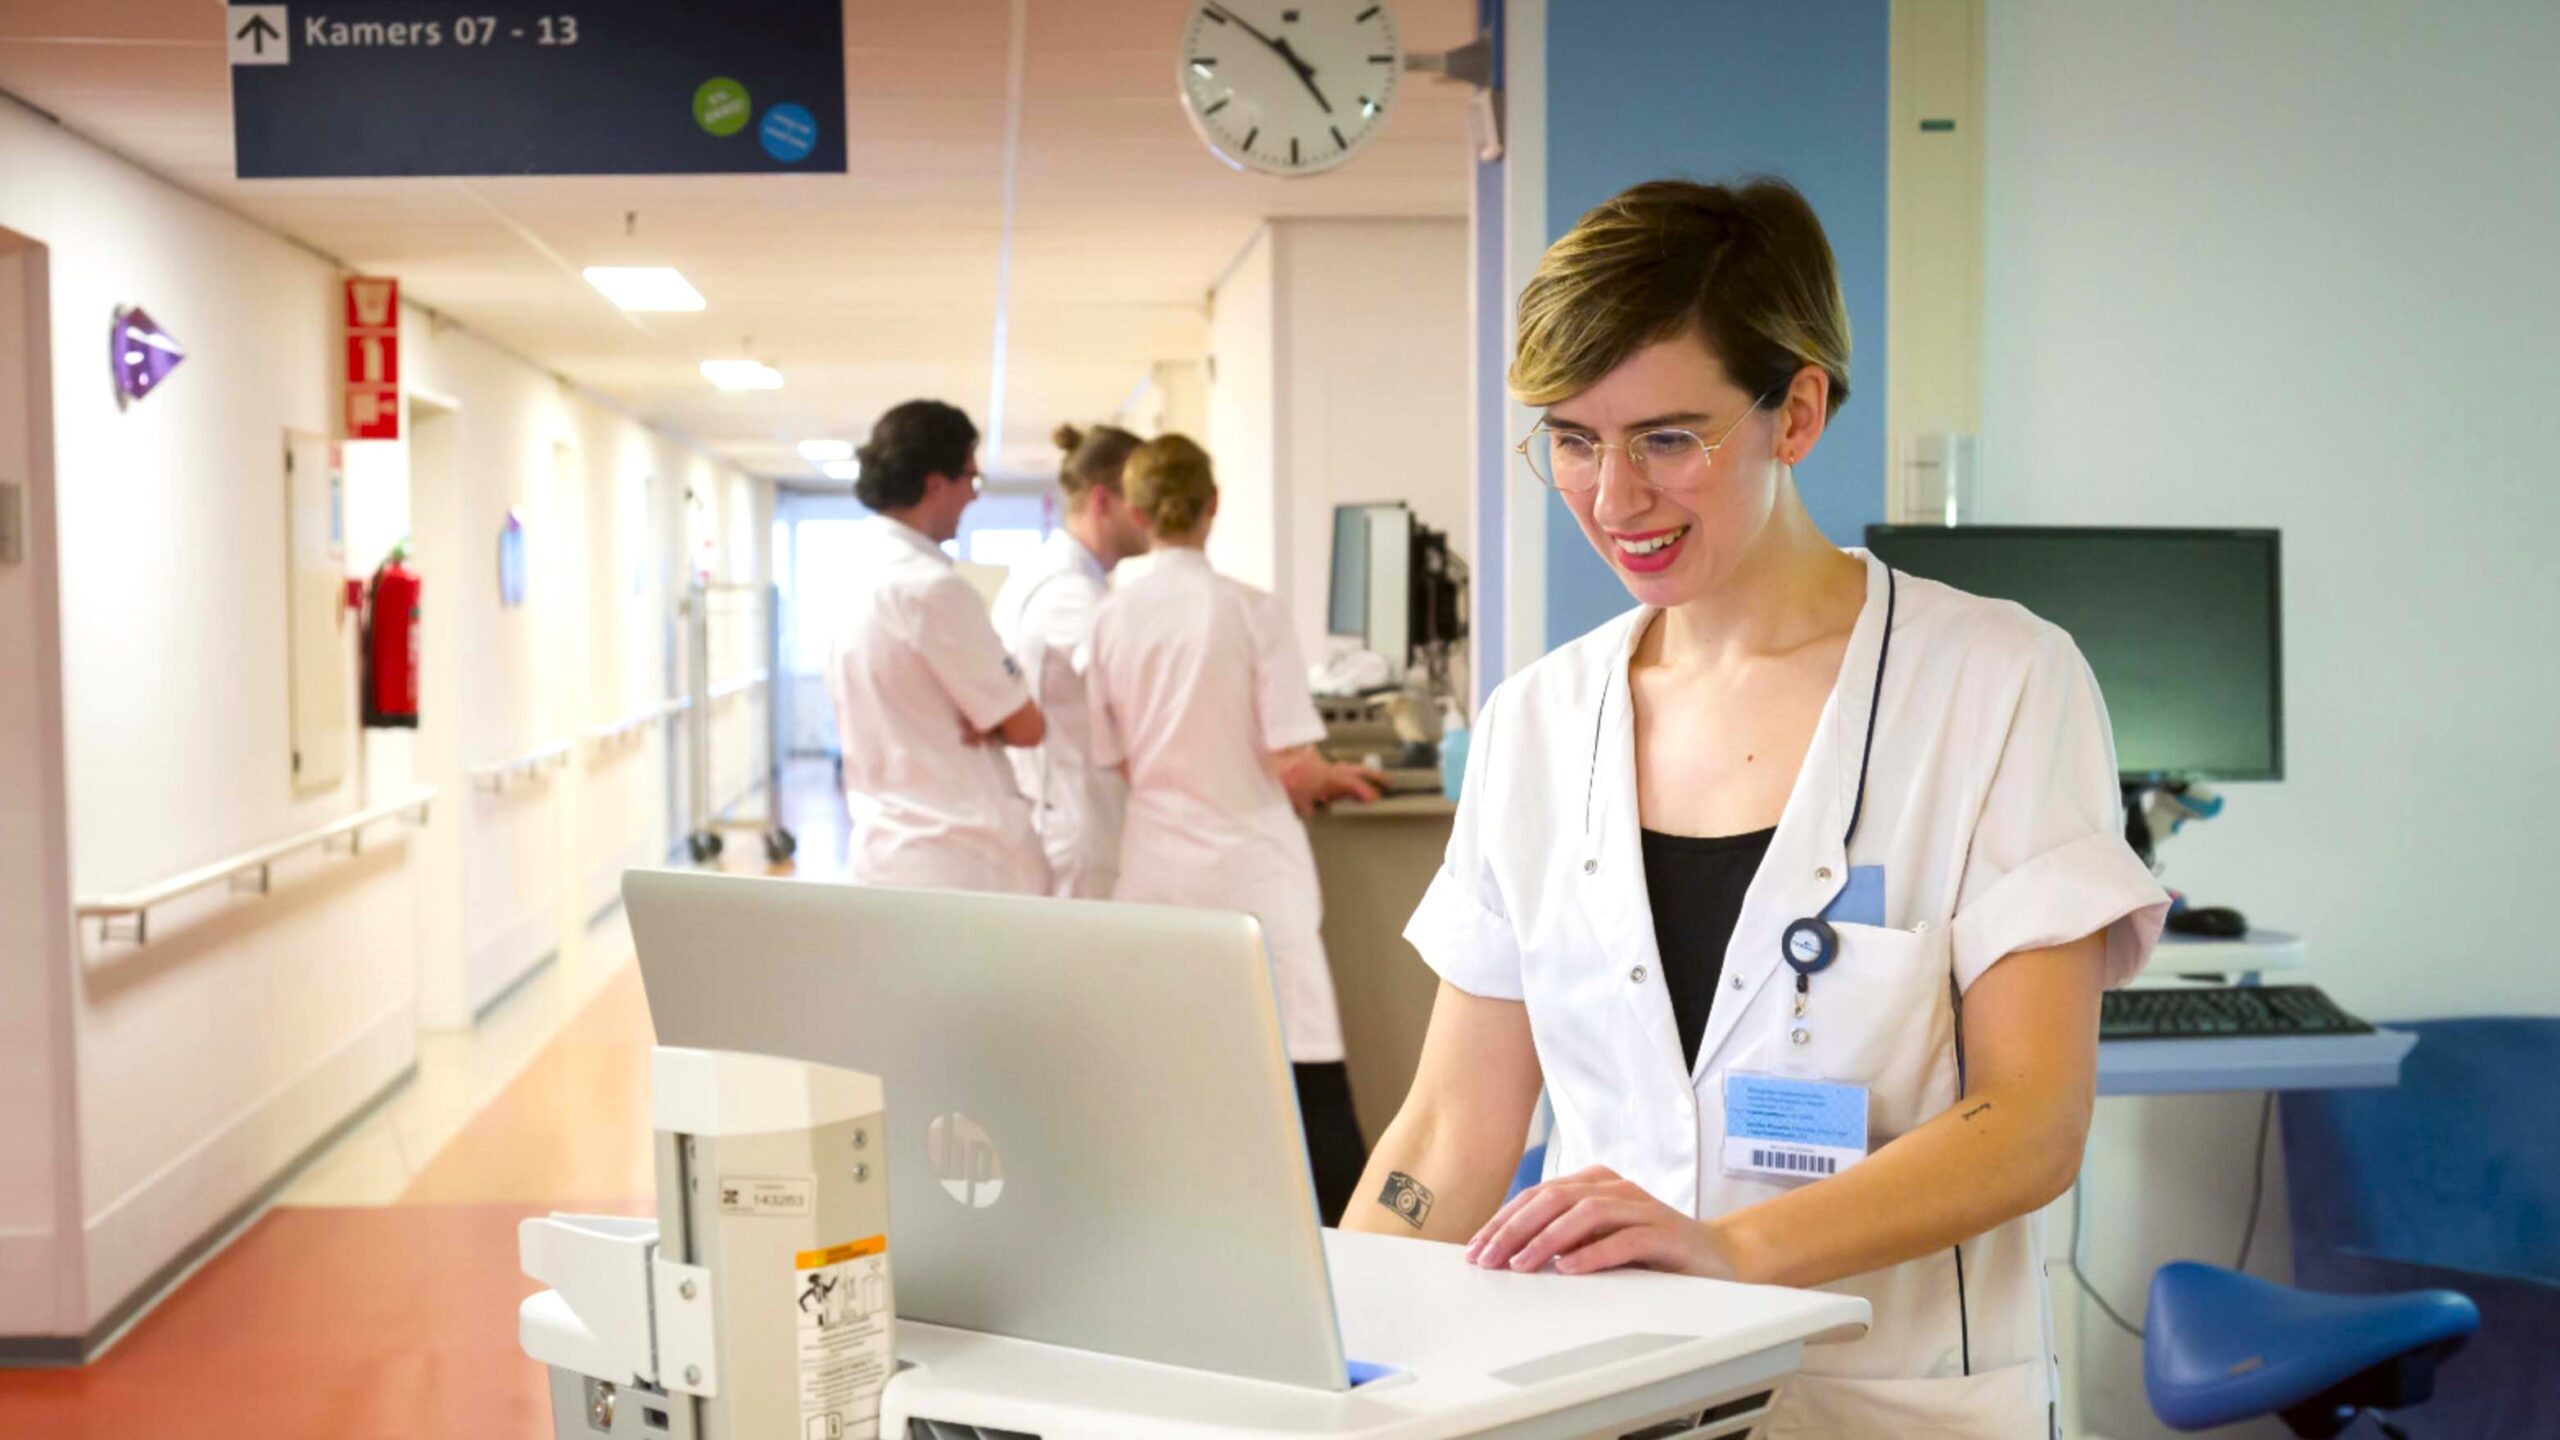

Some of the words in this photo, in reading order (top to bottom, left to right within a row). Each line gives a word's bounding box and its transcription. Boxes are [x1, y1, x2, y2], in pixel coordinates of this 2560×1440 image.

[304, 16, 441, 46] Kamers
[453, 16, 497, 46] 07
[511, 28, 525, 38] -
[537, 15, 579, 45] 13
[927, 1111, 1004, 1208] hp
